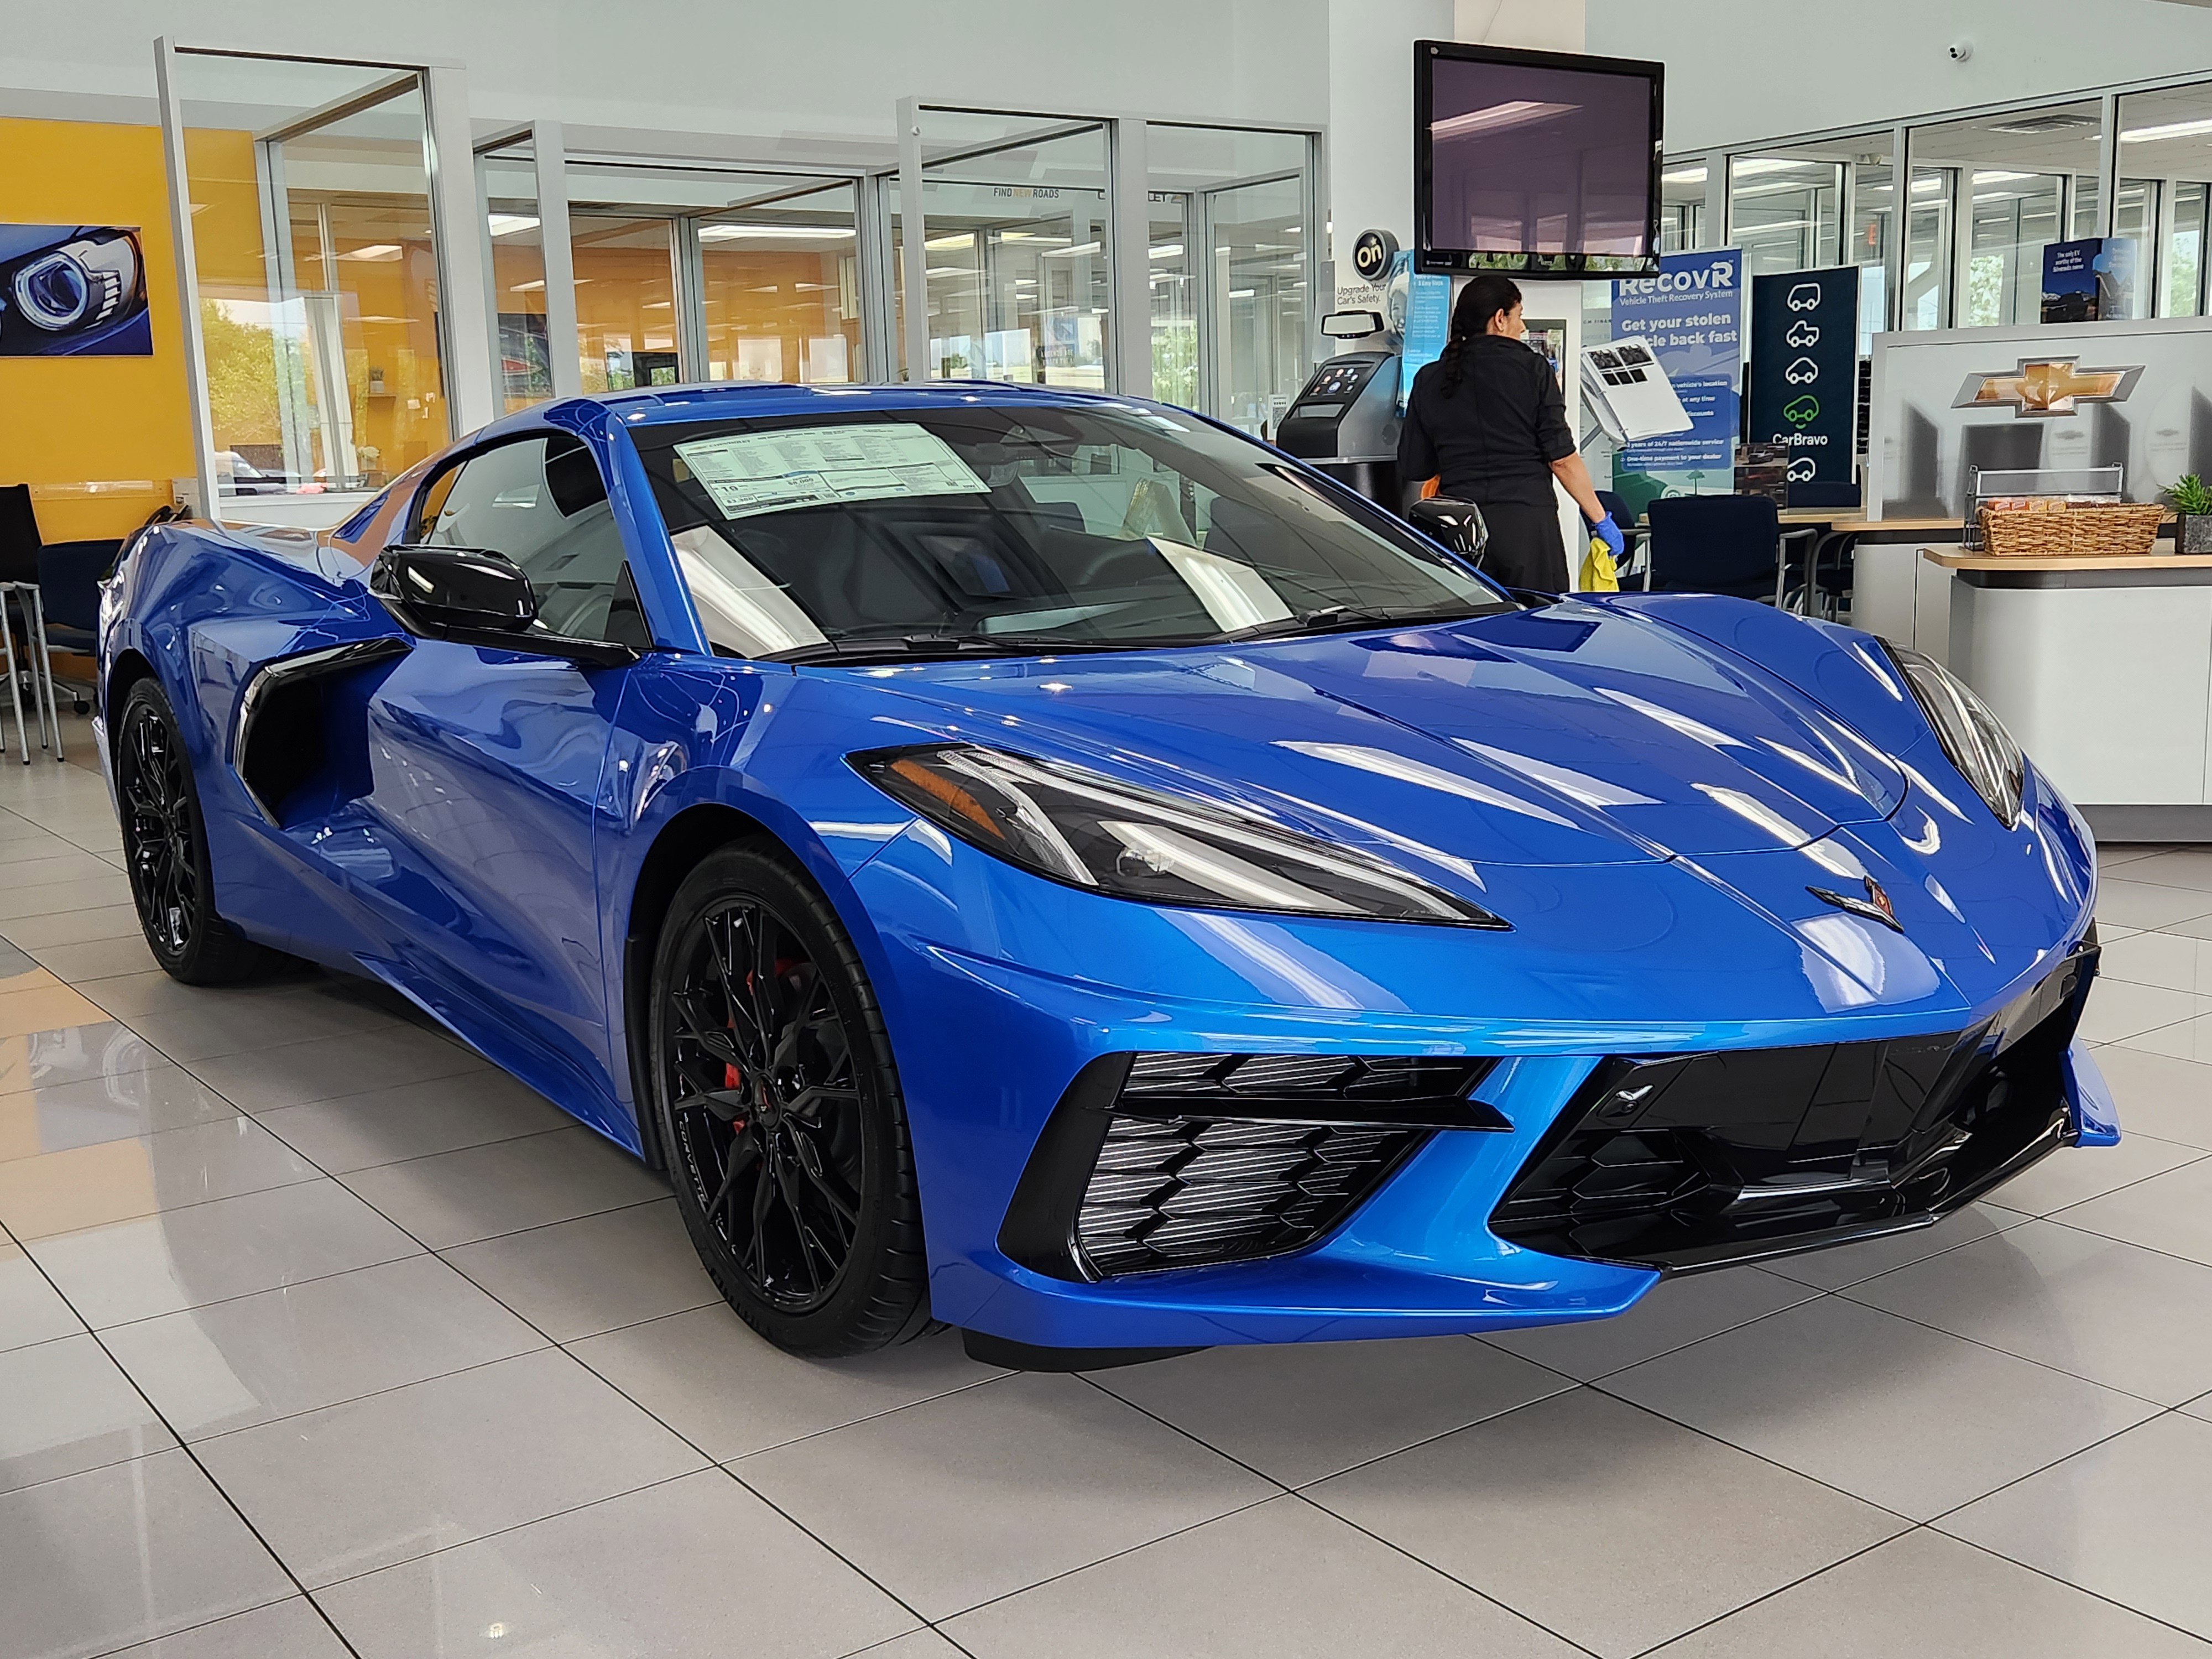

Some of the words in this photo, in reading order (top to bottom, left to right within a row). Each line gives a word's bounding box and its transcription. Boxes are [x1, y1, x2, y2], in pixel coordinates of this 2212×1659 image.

[994, 188, 1012, 197] FIND
[1013, 188, 1032, 197] NEW
[1033, 189, 1060, 198] ROADS
[1337, 284, 1369, 296] Upgrade
[1371, 283, 1386, 292] Your
[1337, 296, 1355, 305] Car's
[1358, 294, 1380, 304] Safety.
[1620, 297, 1646, 306] Vehicle
[1647, 295, 1668, 304] Theft
[1669, 292, 1704, 302] Recovery
[1705, 290, 1733, 300] System
[1621, 319, 1646, 331] Get
[1650, 318, 1682, 332] your
[1686, 312, 1731, 326] stolen
[1670, 332, 1705, 345] back
[1709, 330, 1738, 343] fast
[1772, 432, 1828, 446] CarBravo
